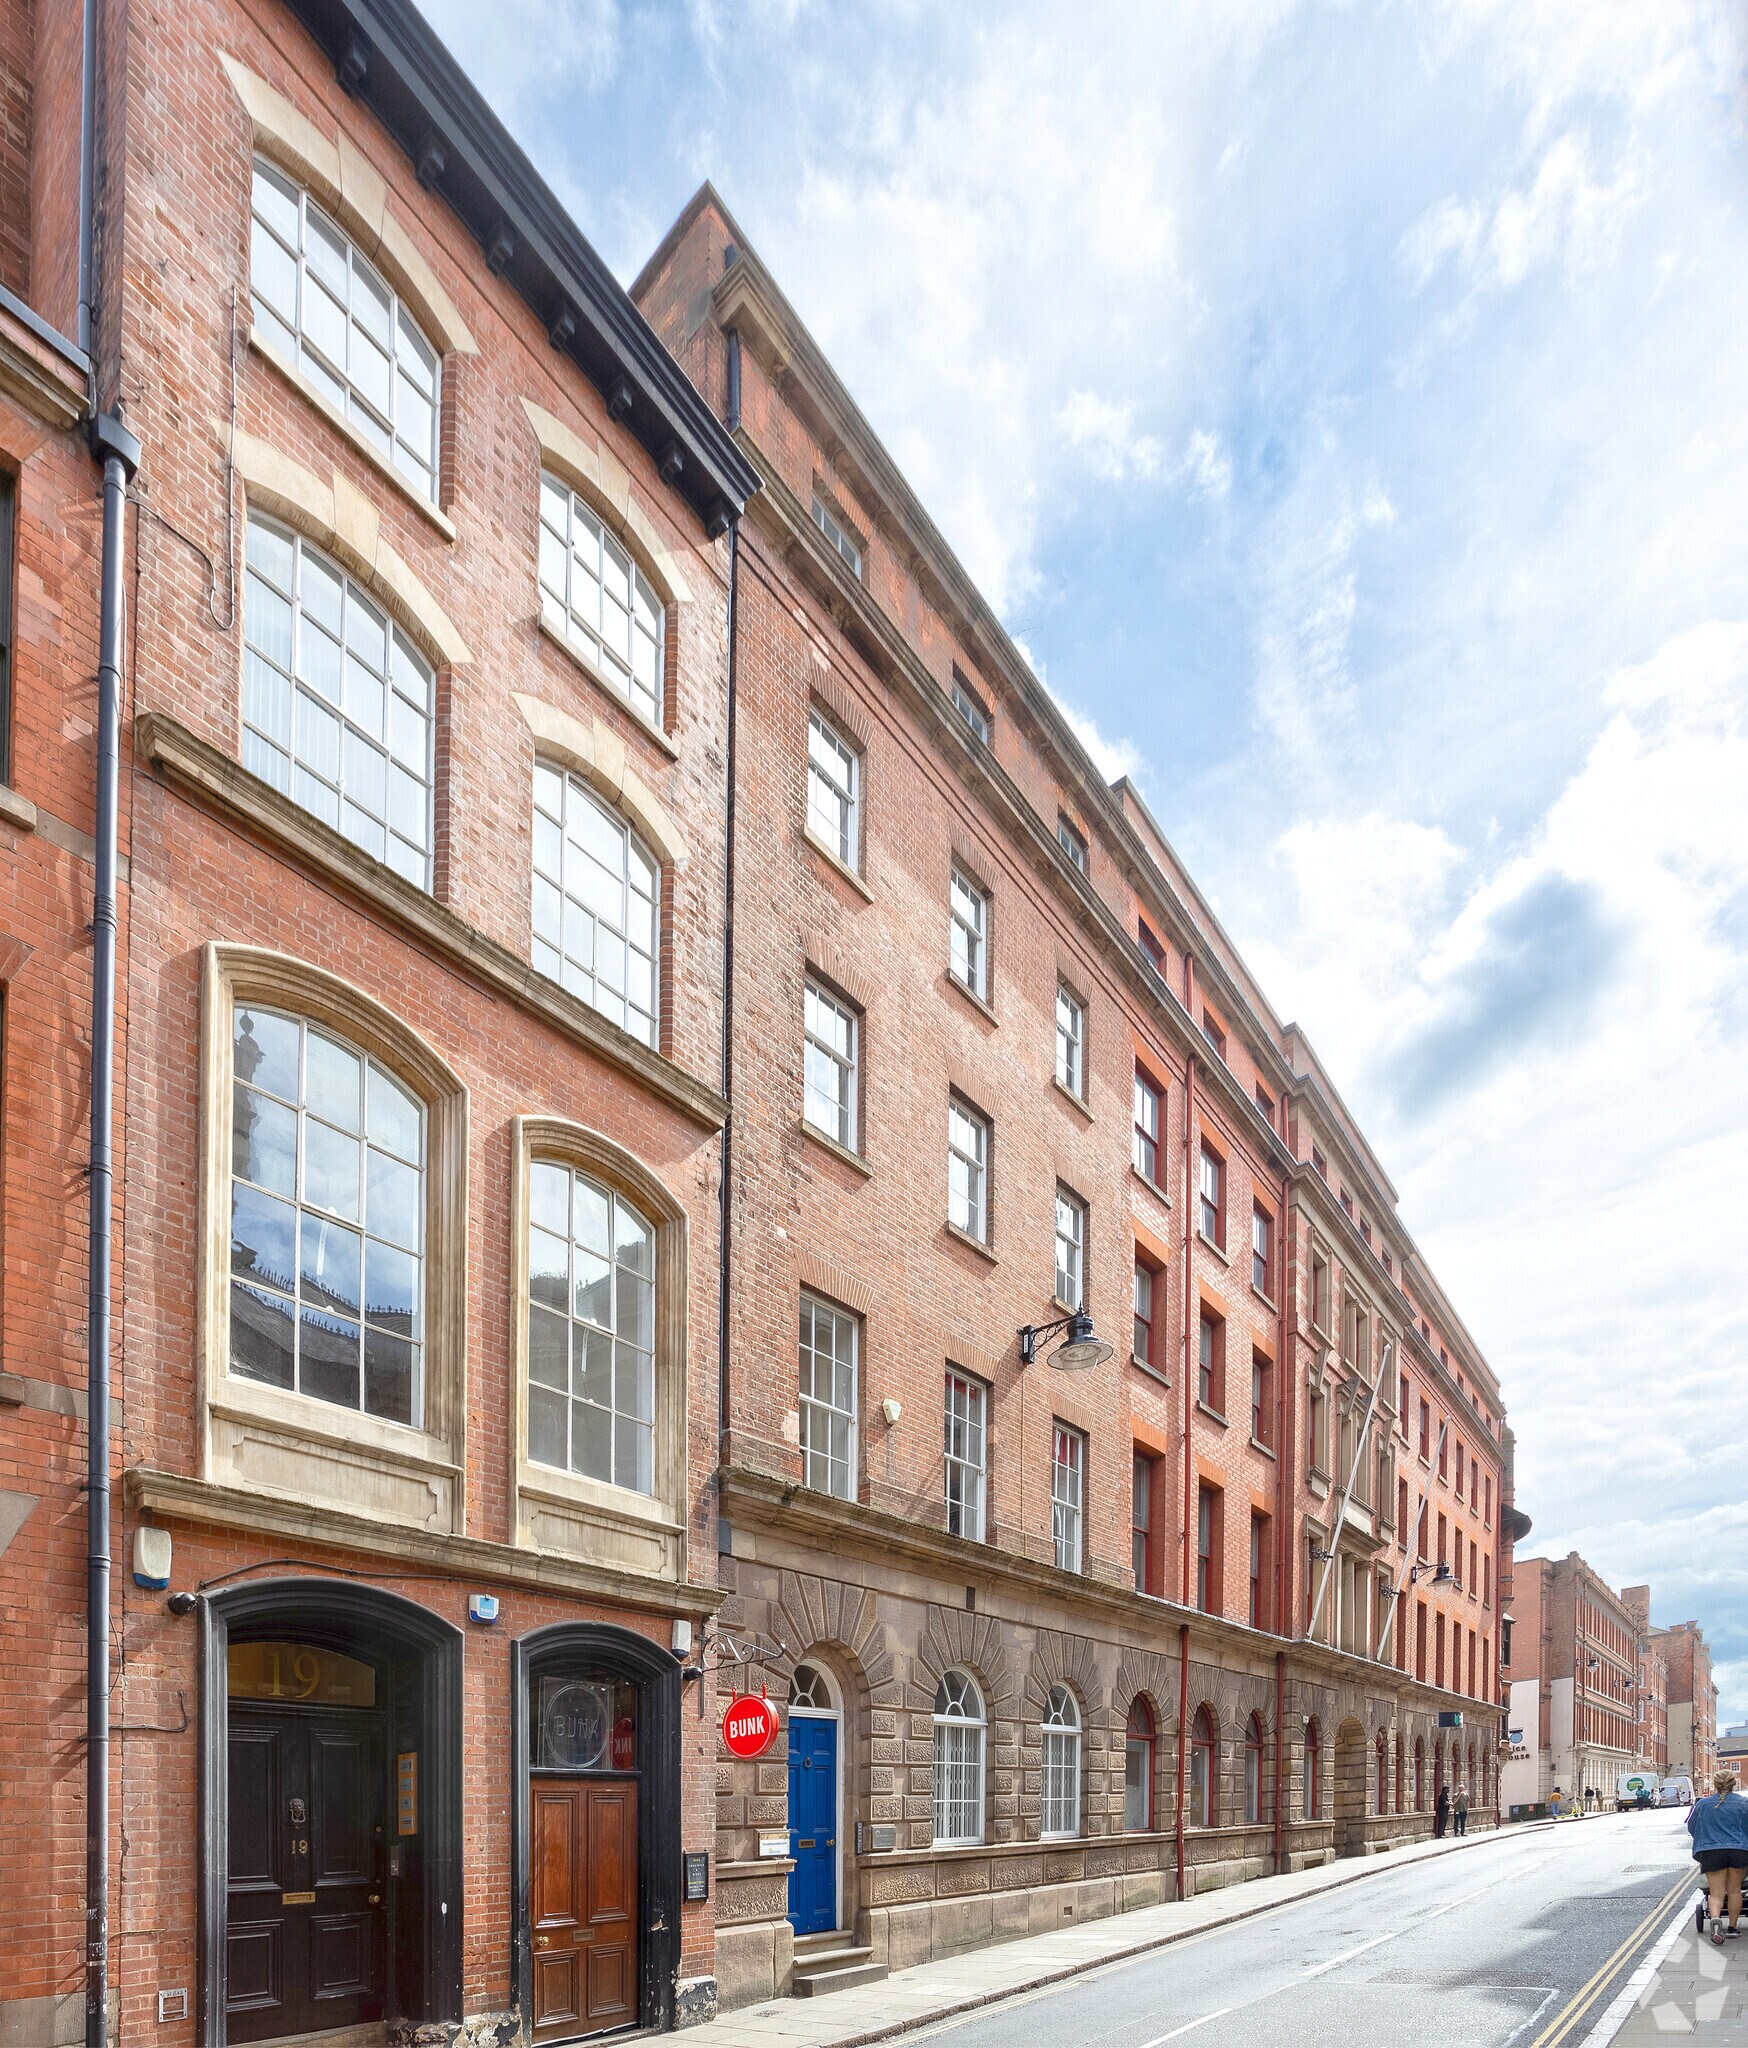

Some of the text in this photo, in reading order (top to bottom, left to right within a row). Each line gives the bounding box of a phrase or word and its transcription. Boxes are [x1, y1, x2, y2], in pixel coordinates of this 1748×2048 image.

[267, 1651, 320, 1698] 19
[554, 1715, 598, 1739] BUNK
[729, 1715, 766, 1739] BUNK
[291, 1839, 308, 1855] 19
